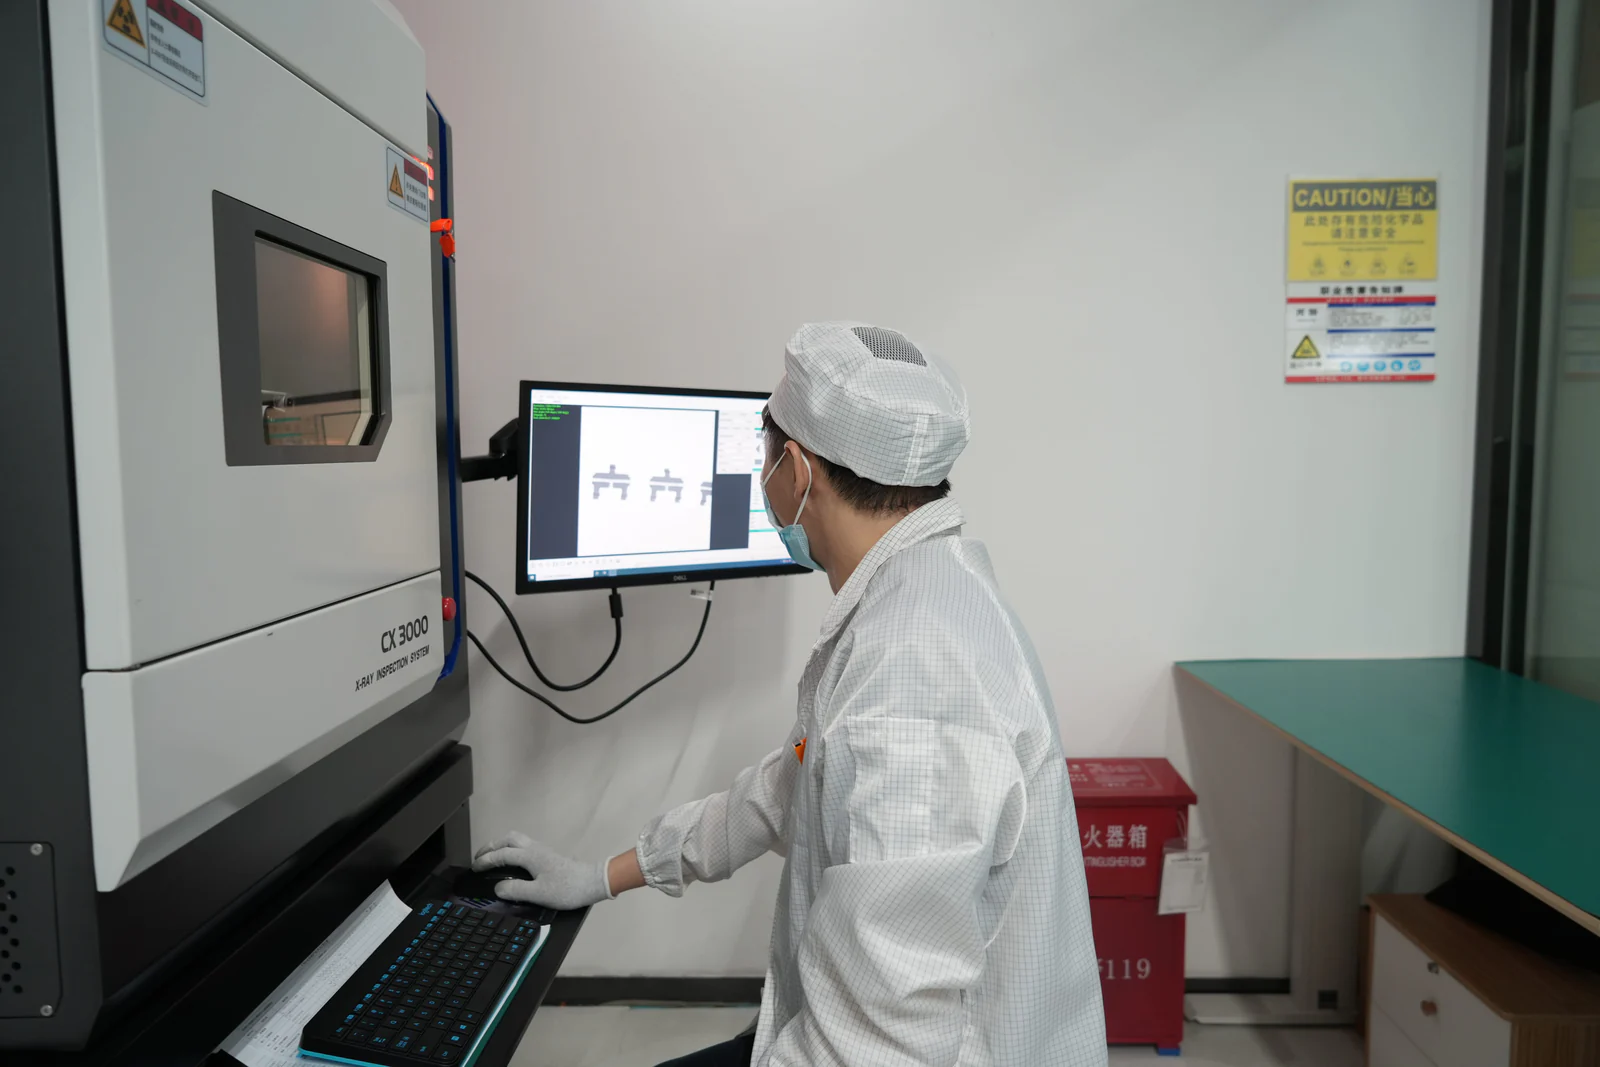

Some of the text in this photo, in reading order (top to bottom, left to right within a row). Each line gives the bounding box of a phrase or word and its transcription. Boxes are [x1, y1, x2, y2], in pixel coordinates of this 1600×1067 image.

[1295, 186, 1434, 209] CAUTION/当心
[381, 615, 429, 653] CX 3000
[355, 644, 430, 692] X-RAY INSPECTION SYSTEM
[1083, 824, 1148, 849] 火器箱
